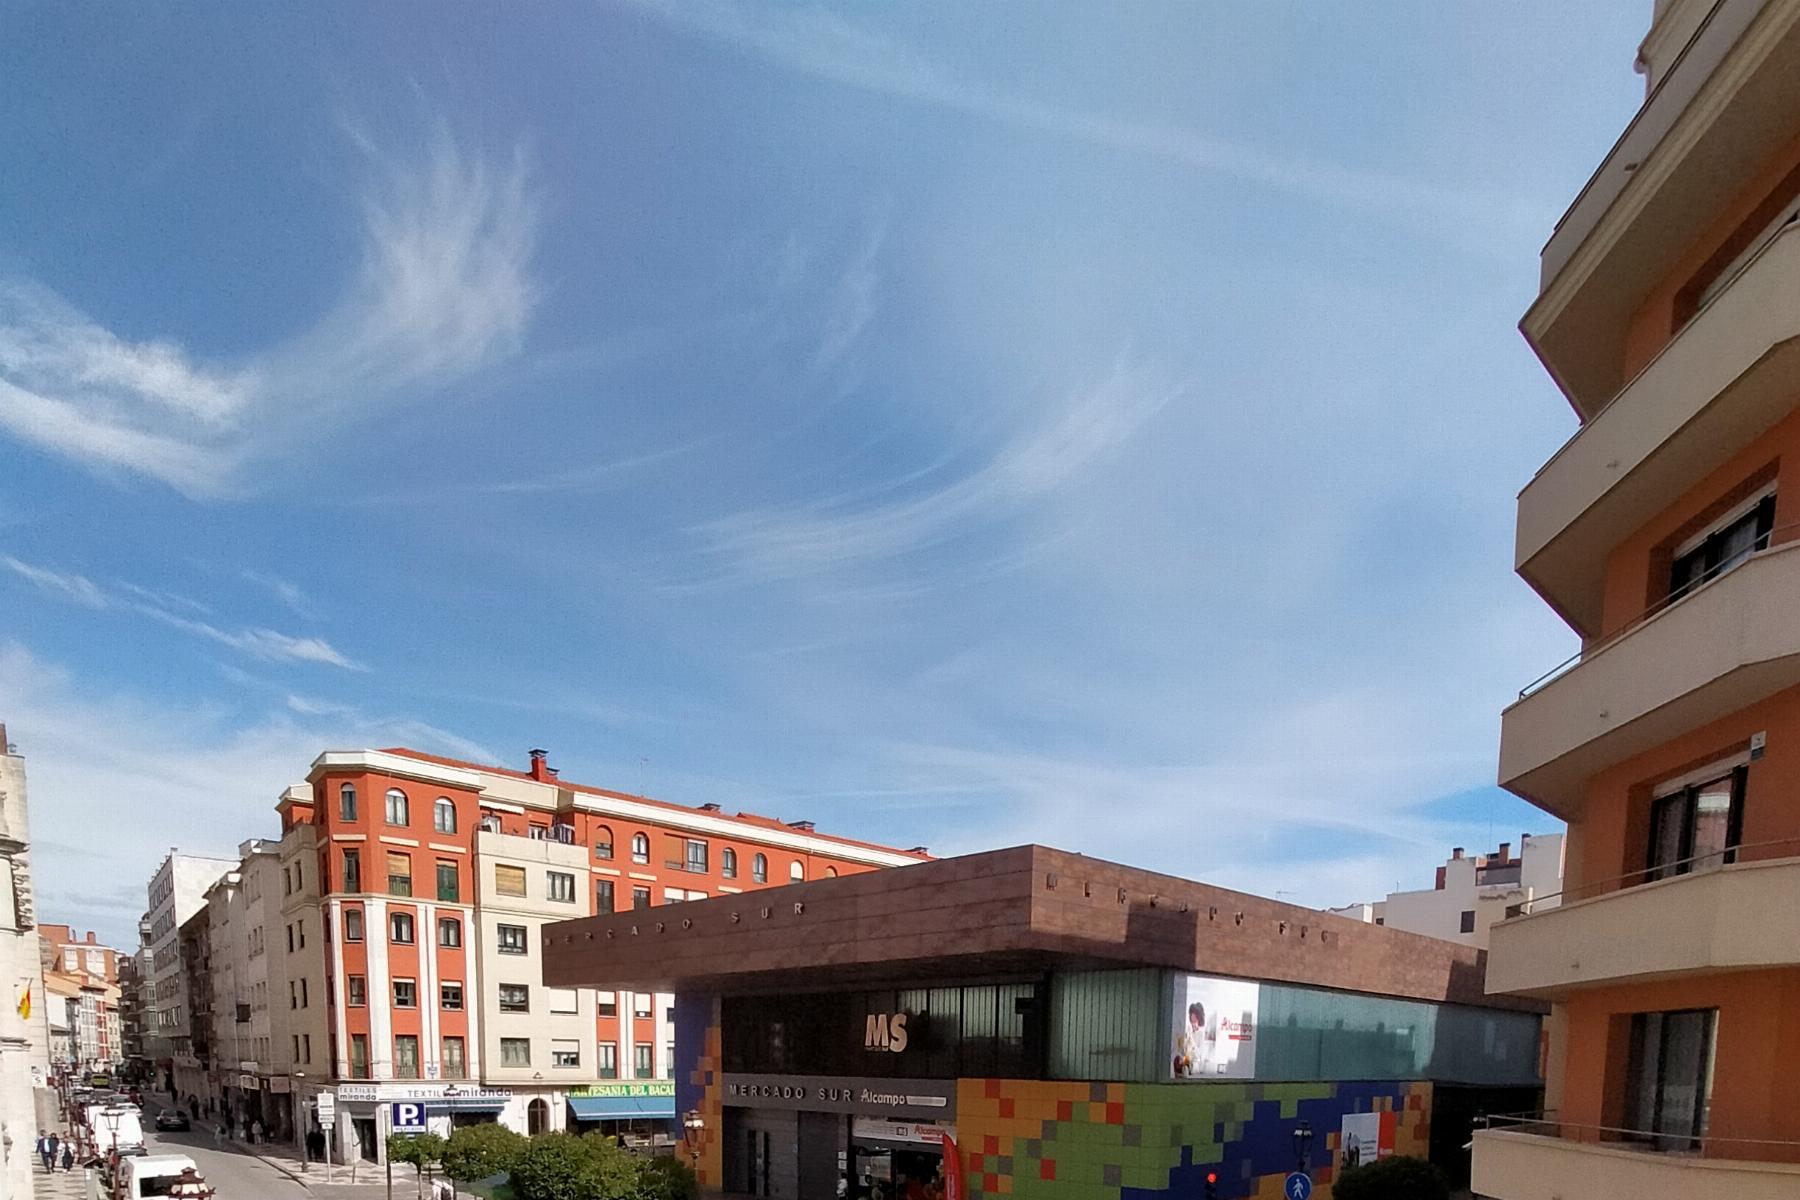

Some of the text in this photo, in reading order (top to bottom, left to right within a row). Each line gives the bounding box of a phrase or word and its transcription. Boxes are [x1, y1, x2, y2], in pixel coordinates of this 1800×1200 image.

[730, 902, 805, 924] SUR
[864, 1013, 908, 1053] MS
[338, 1086, 377, 1094] TEXTILES
[459, 1086, 512, 1097] miranda
[630, 1083, 648, 1096] DEL
[729, 1083, 805, 1100] MERCADO
[818, 1088, 852, 1102] SUR
[860, 1088, 906, 1107] Alcampo
[339, 1093, 377, 1101] miranda
